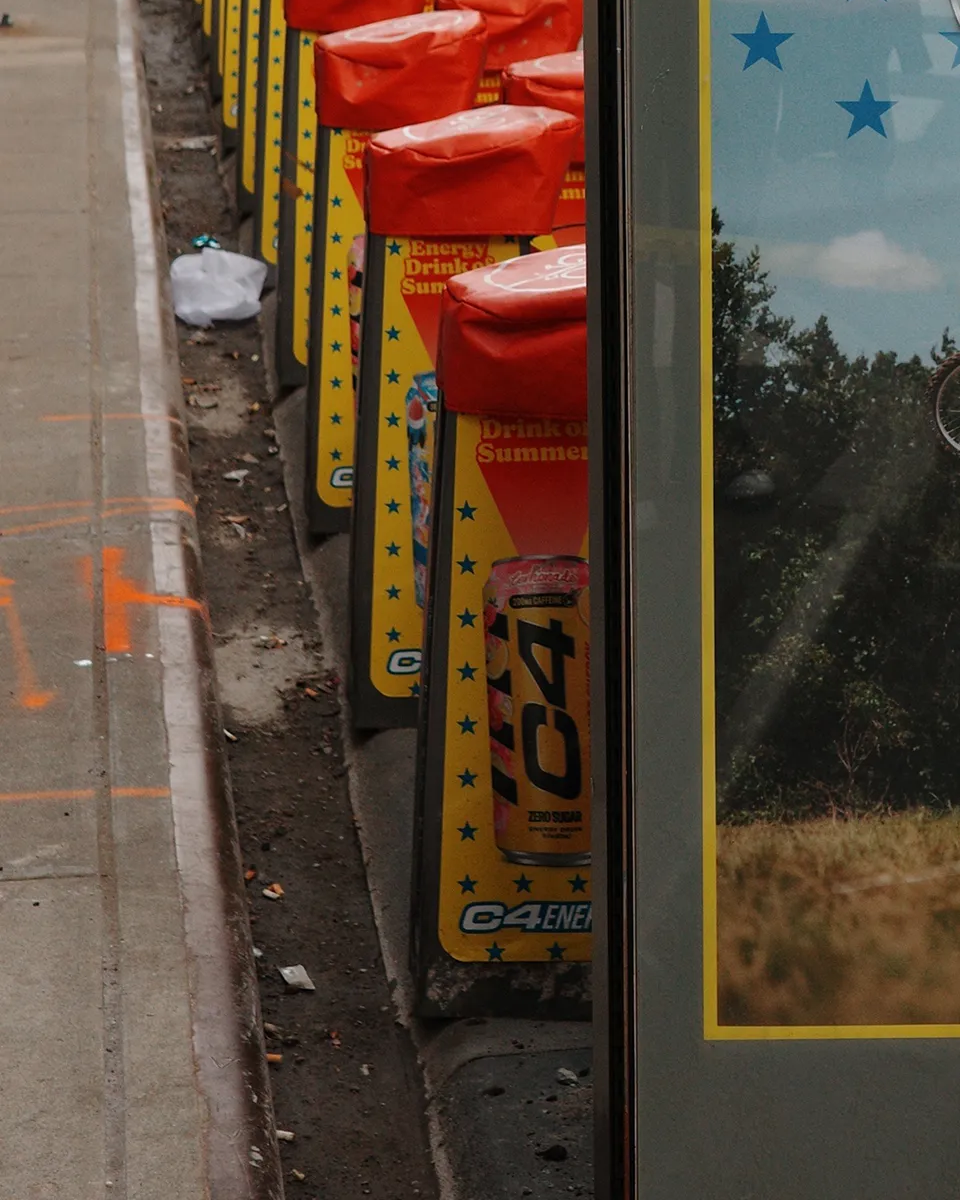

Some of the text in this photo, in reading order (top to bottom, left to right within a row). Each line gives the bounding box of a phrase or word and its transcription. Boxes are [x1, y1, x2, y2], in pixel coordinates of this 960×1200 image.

[410, 240, 487, 259] Energy
[405, 257, 468, 276] Drink
[482, 418, 562, 439] Drink
[517, 618, 582, 801] C4
[462, 902, 544, 932] C4
